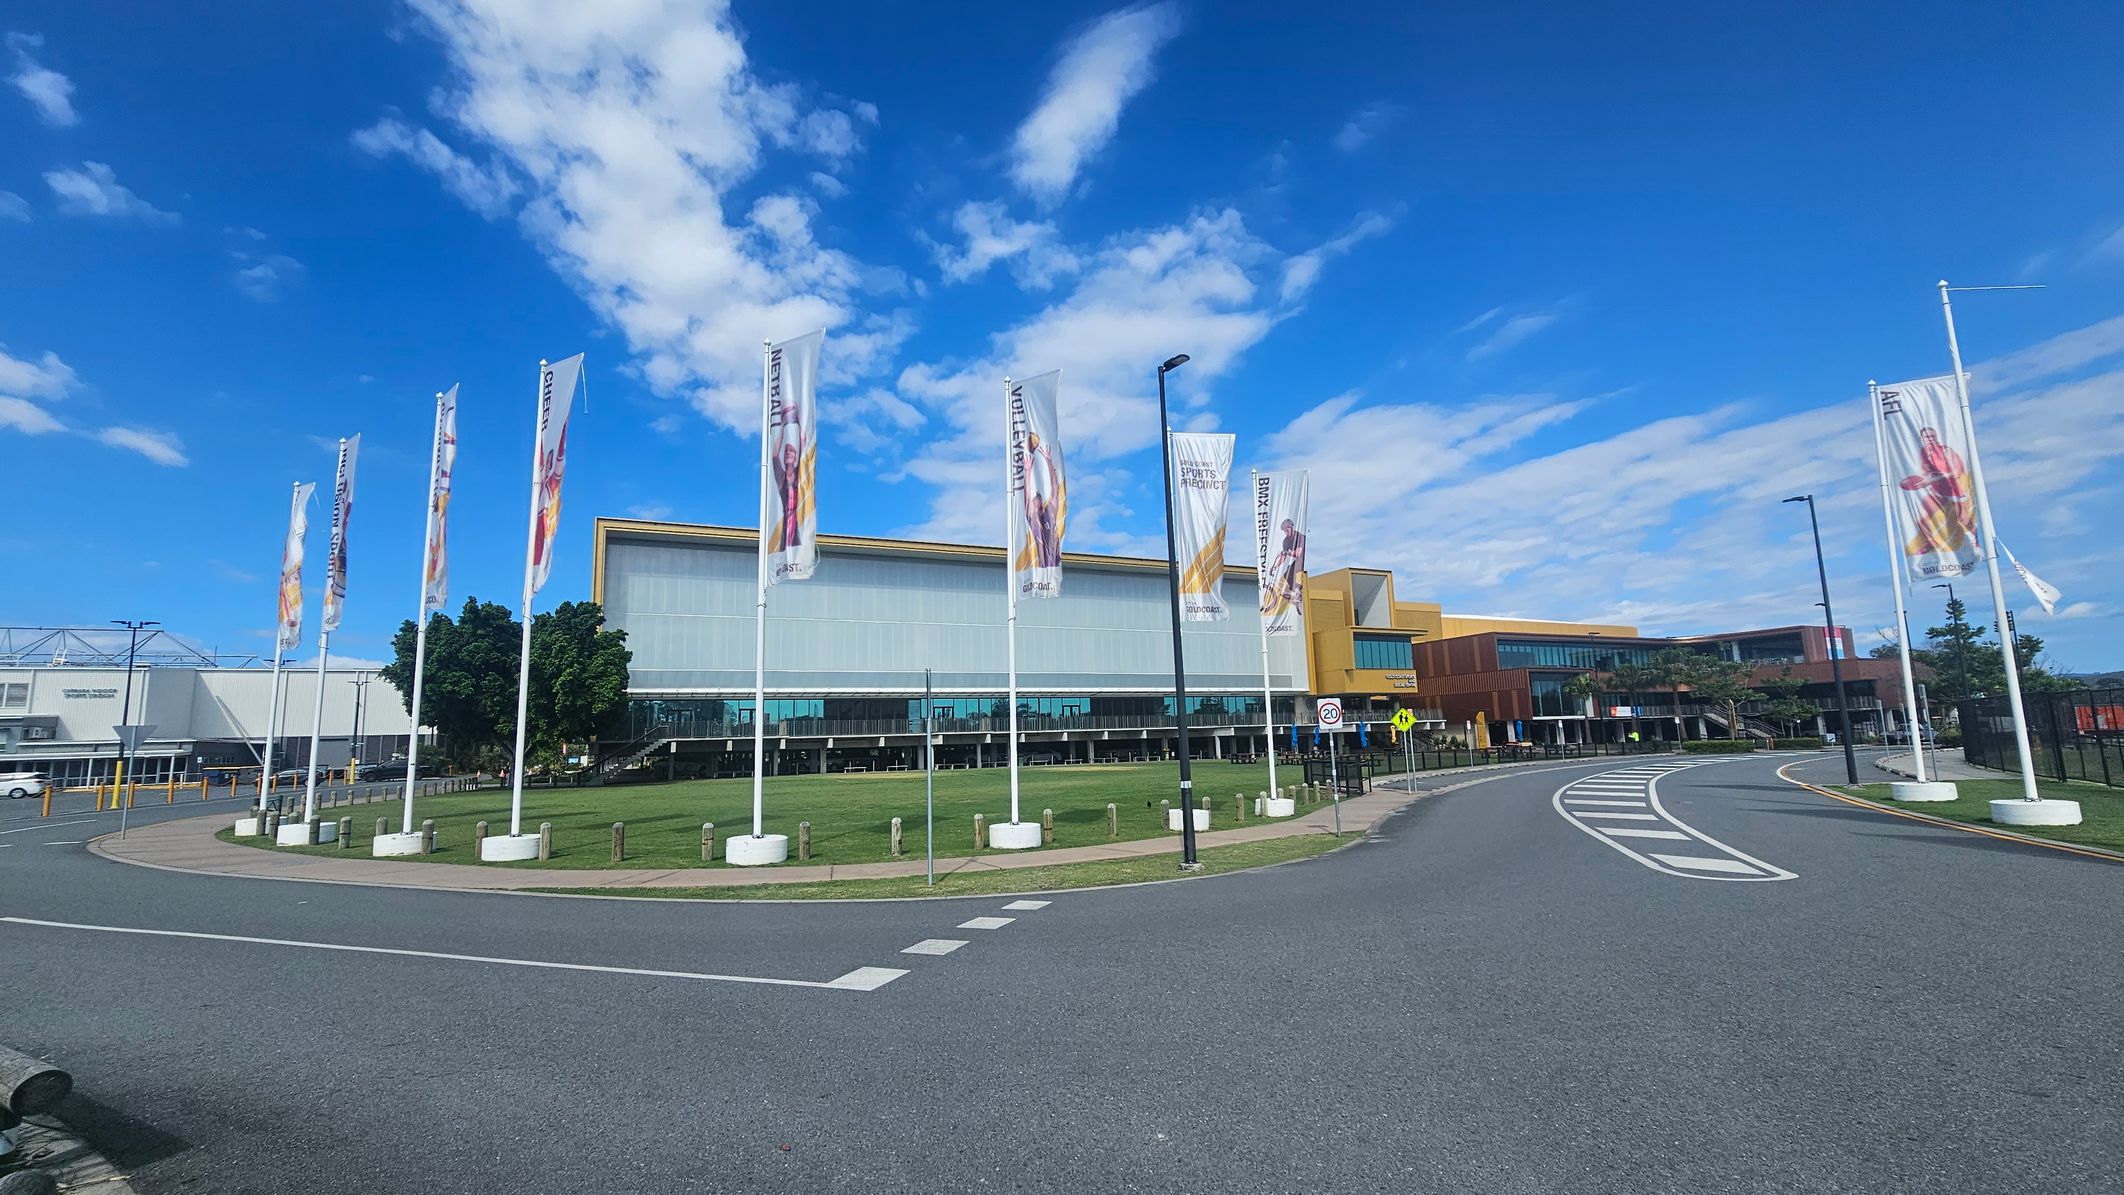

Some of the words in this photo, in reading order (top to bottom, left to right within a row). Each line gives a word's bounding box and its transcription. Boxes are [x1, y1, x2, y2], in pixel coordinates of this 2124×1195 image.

[541, 370, 554, 433] CHEER
[770, 348, 783, 435] NETBALL
[1880, 390, 1903, 421] AFL
[1011, 385, 1026, 496] VOLLEYBALL
[1180, 477, 1227, 490] PRECINCT
[1181, 467, 1217, 480] SPORTS
[1258, 477, 1270, 508] BMX
[1323, 708, 1338, 719] 20
